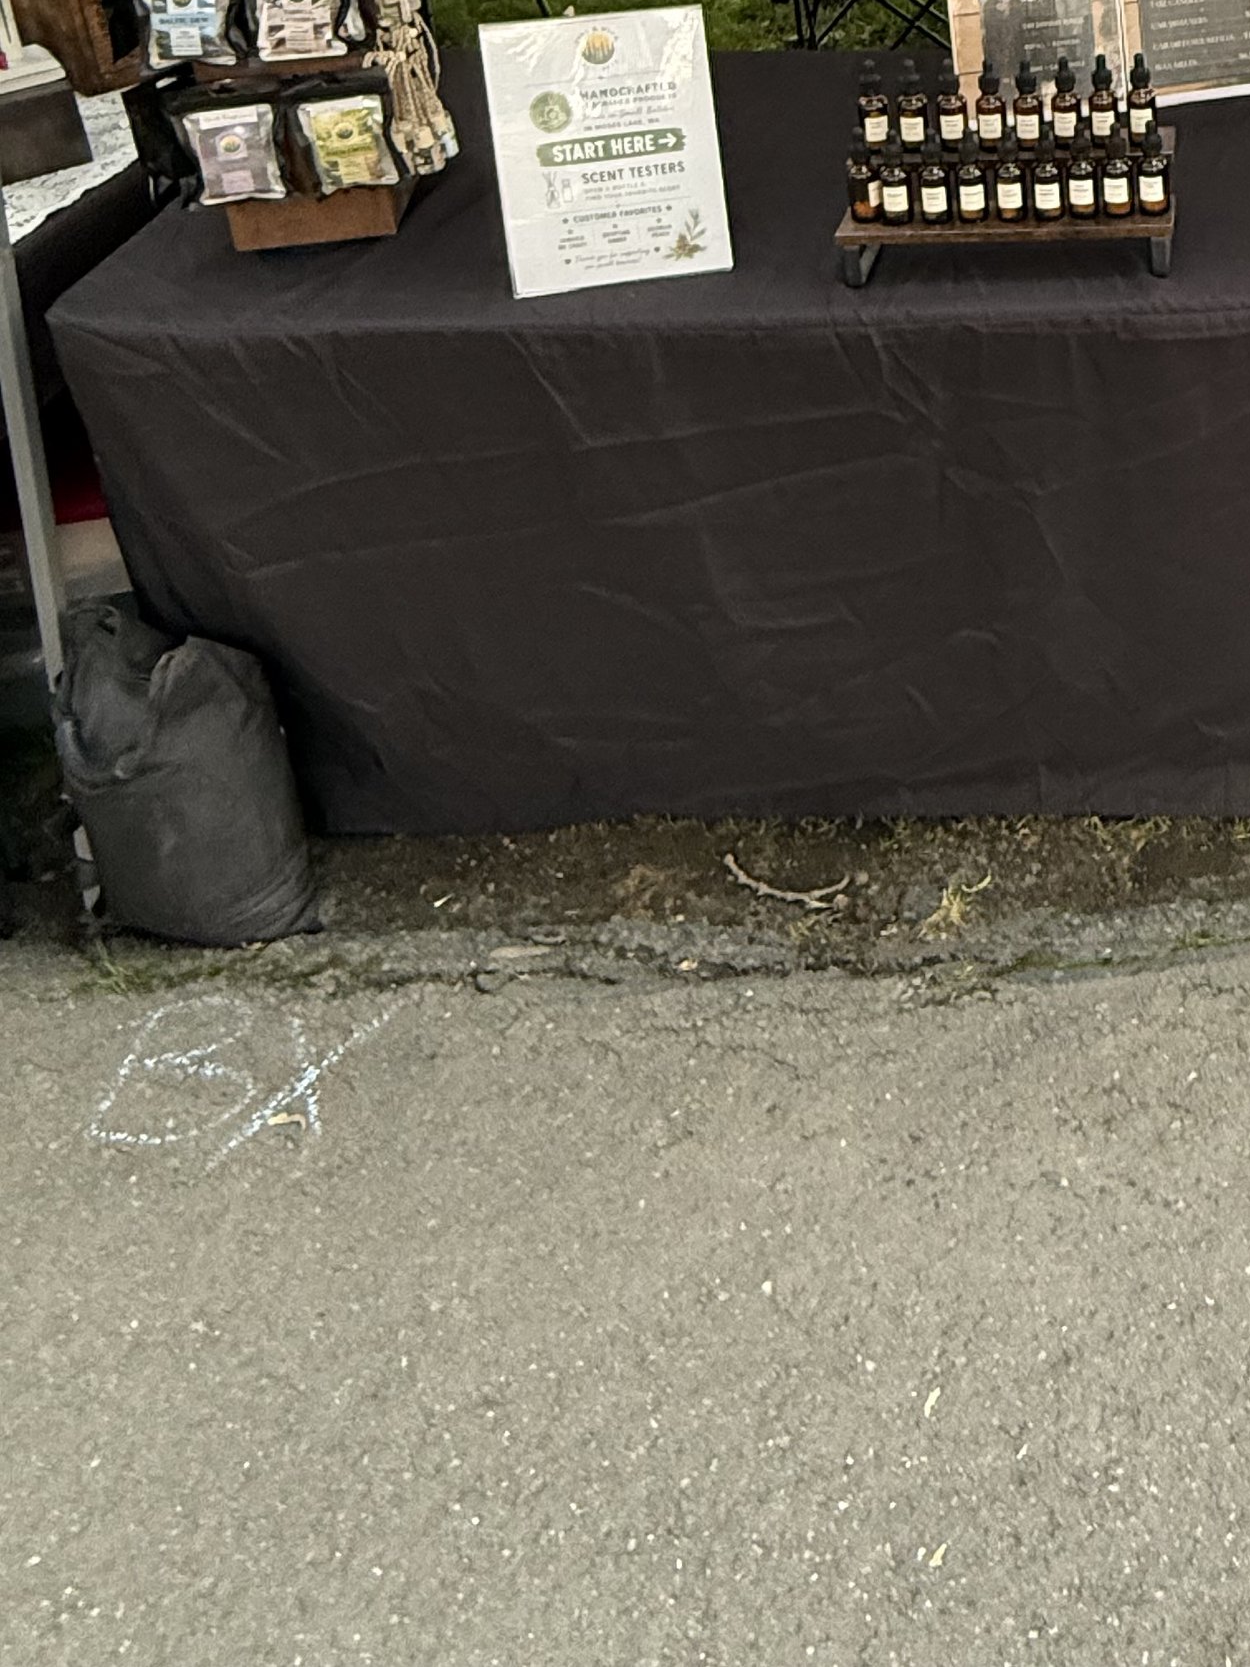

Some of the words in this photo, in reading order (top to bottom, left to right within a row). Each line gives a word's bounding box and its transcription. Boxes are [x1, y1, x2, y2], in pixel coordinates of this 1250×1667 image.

[552, 140, 605, 163] START
[610, 134, 656, 156] HERE
[581, 168, 624, 184] SCENT
[629, 160, 686, 178] TESTERS
[619, 205, 662, 218] FAVORITES
